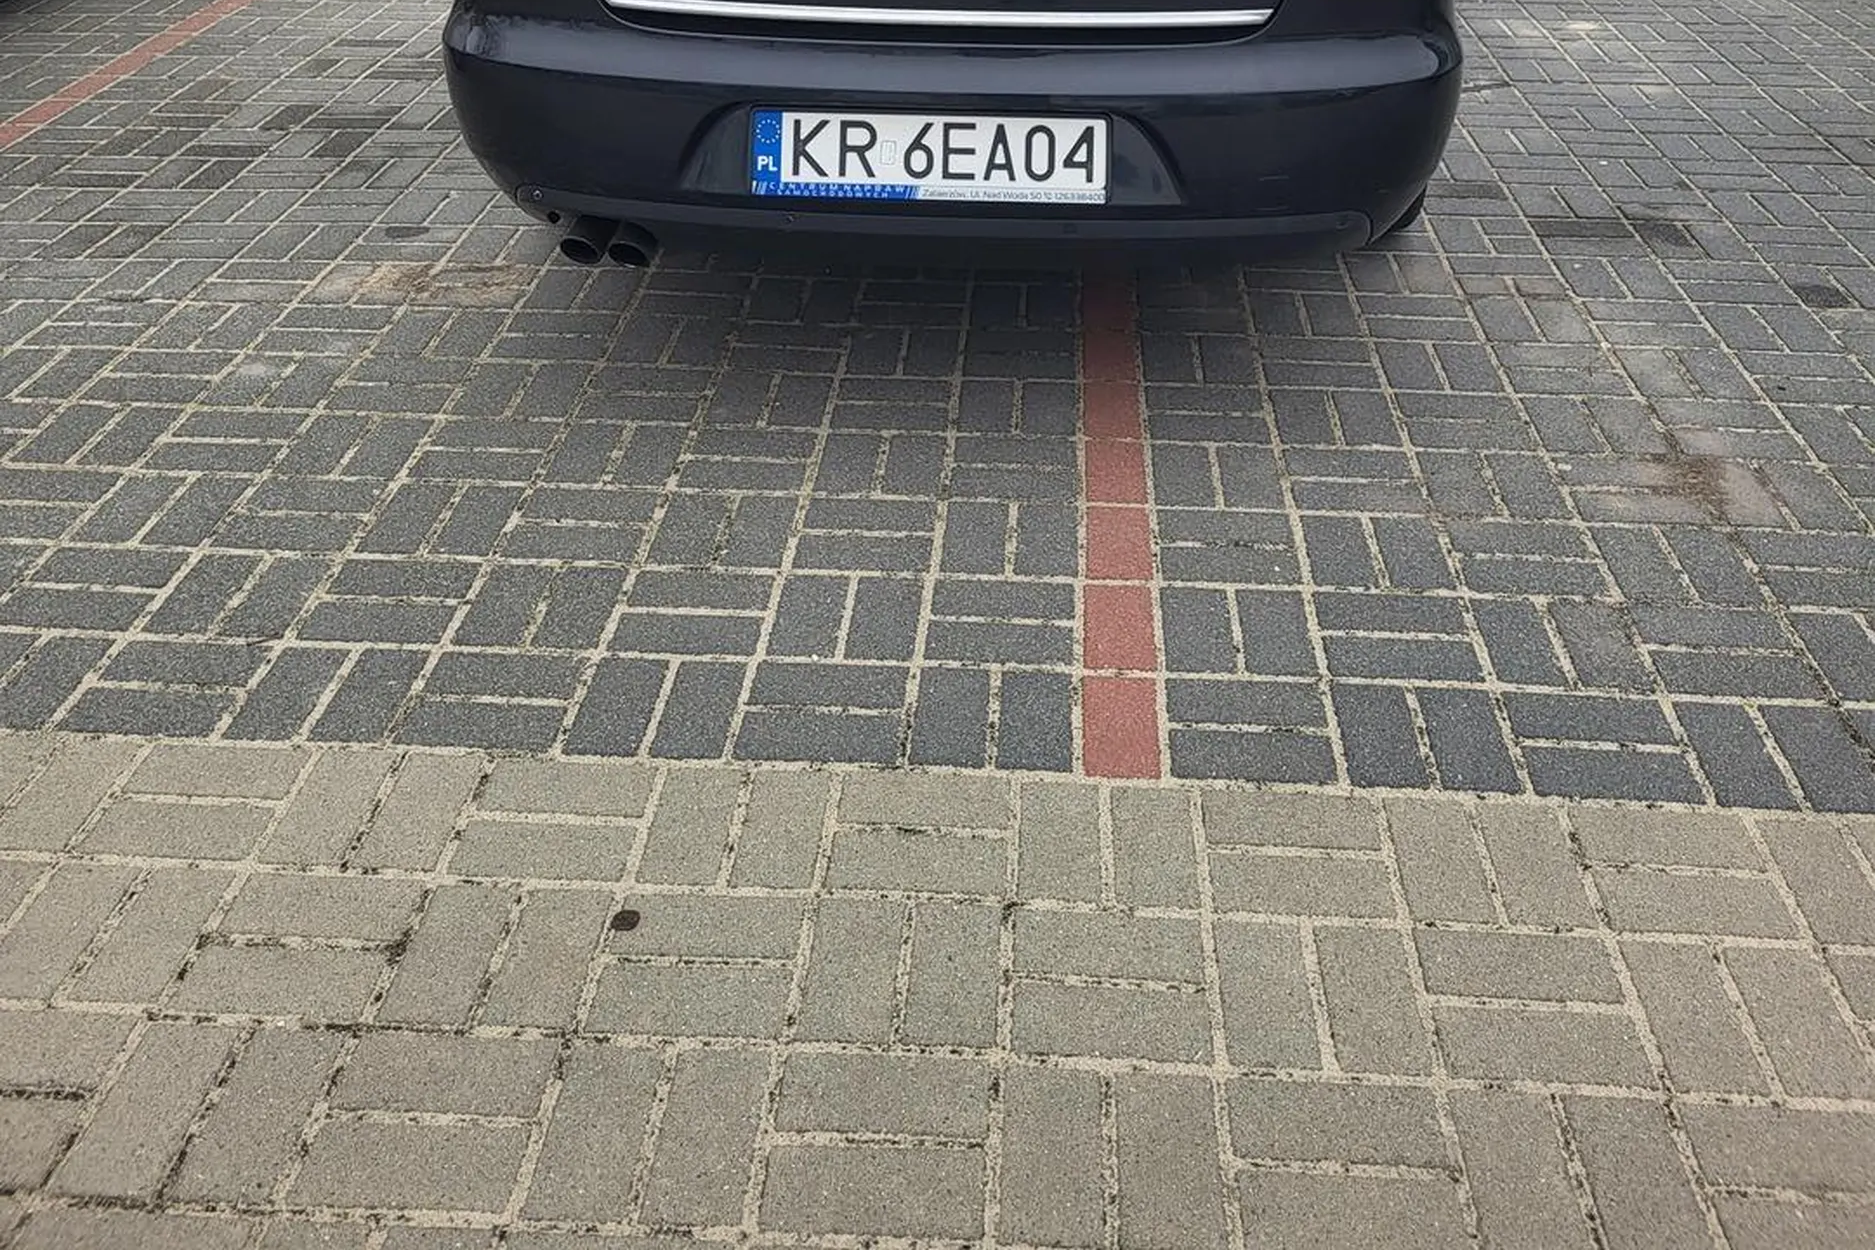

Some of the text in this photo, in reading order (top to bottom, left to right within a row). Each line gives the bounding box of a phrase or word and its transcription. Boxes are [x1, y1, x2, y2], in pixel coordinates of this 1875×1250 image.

[757, 156, 778, 172] PL
[792, 118, 1095, 183] KR 6EA04
